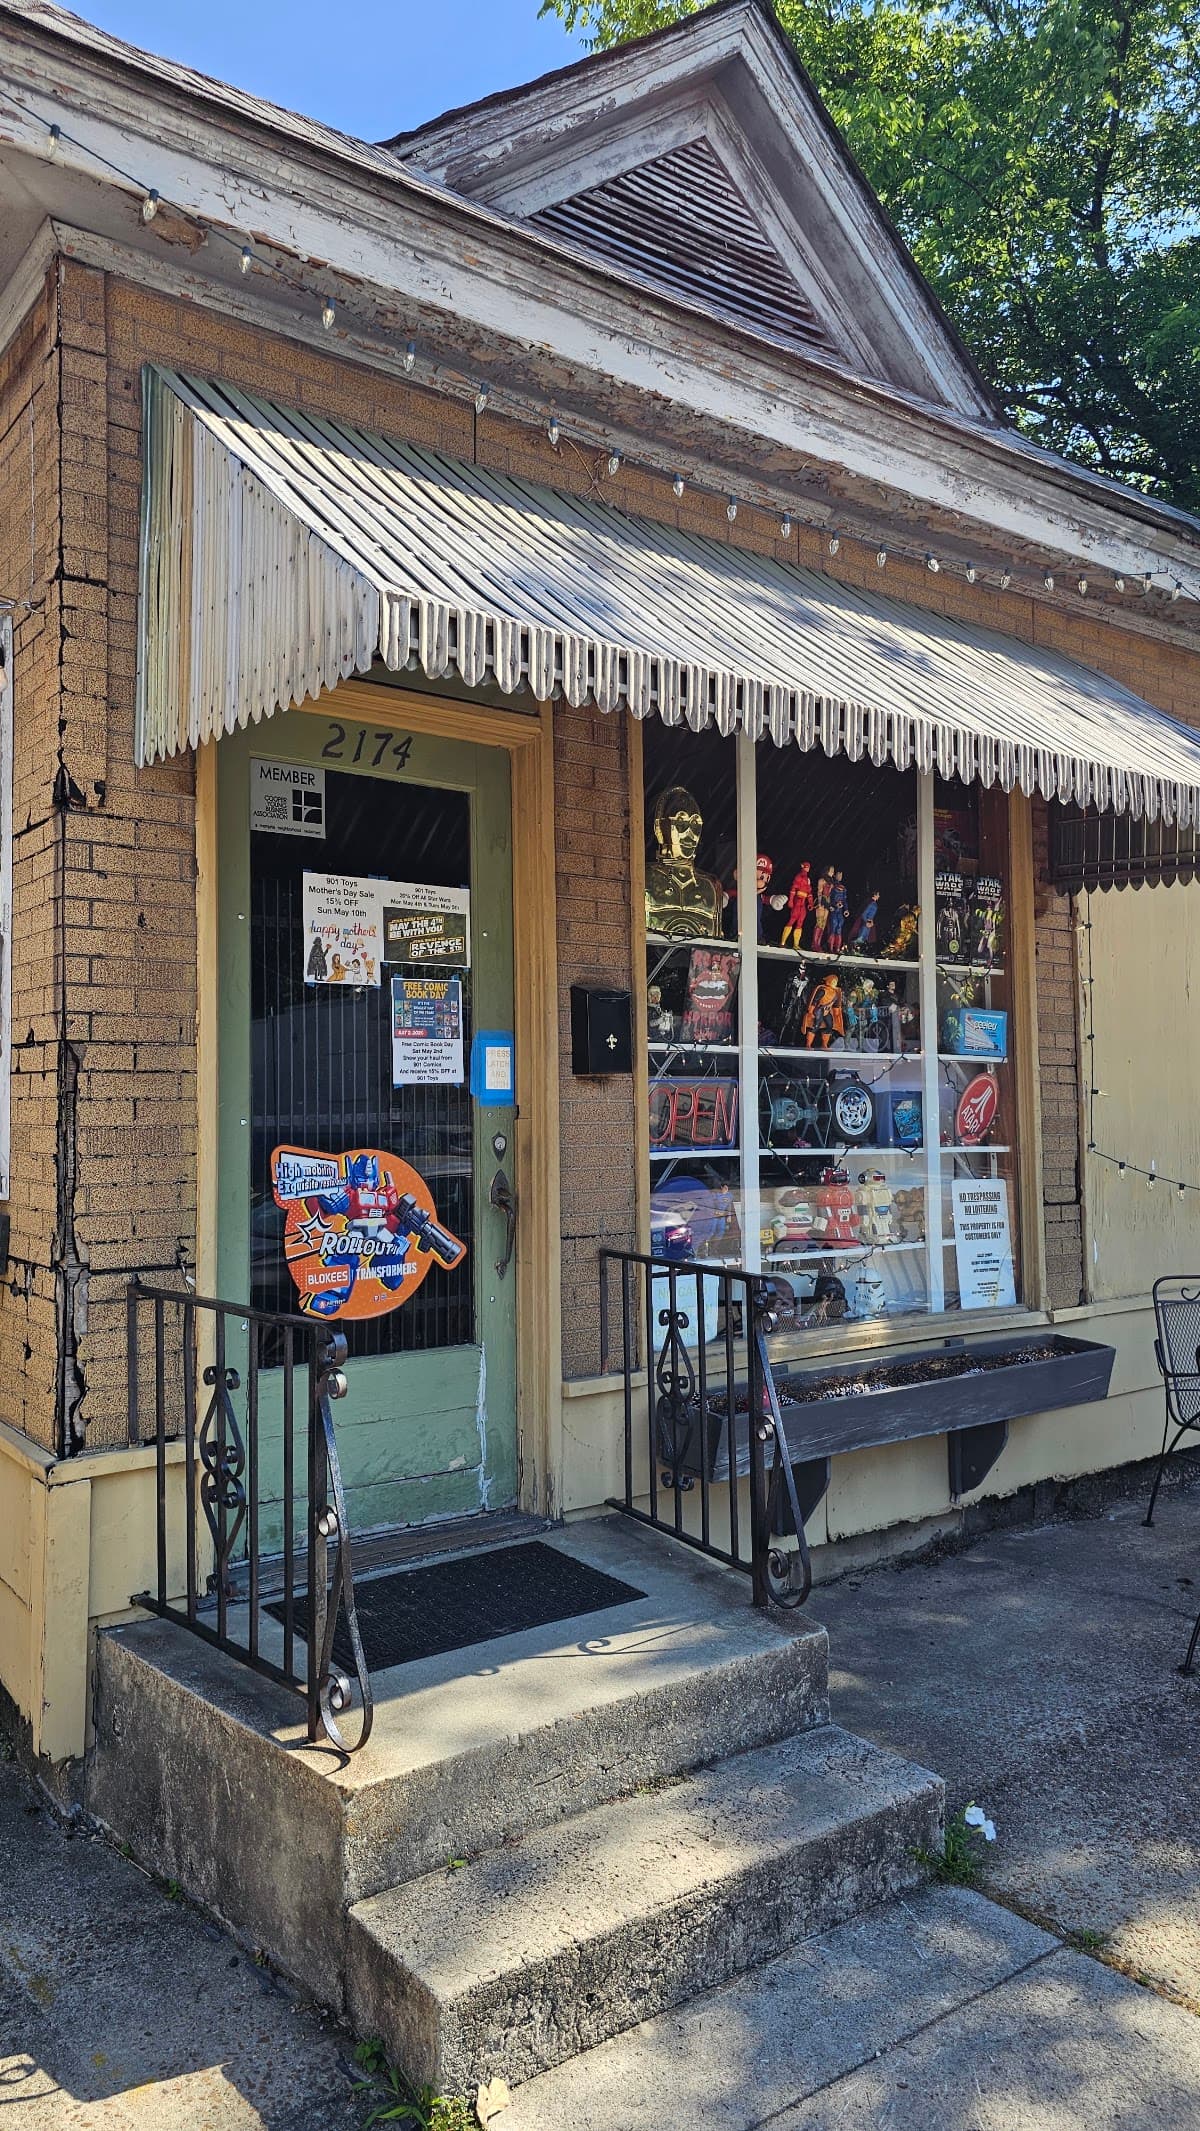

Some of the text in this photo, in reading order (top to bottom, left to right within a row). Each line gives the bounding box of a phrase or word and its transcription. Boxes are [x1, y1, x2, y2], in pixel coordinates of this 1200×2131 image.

[322, 723, 413, 771] 2174
[260, 766, 315, 786] MEMBER
[253, 810, 288, 820] ASSOCIATION
[935, 872, 962, 883] STAR
[977, 877, 1002, 888] STAR
[340, 879, 358, 888] Toys
[935, 881, 964, 892] WARS
[308, 886, 342, 896] Mother's
[343, 889, 357, 898] Day
[976, 886, 1001, 897] WARS
[326, 898, 342, 906] 15%
[334, 908, 349, 917] May
[310, 920, 340, 942] happy
[390, 922, 409, 931] MAY
[412, 920, 429, 928] THE
[403, 928, 424, 937] WITH
[425, 925, 443, 934] YOU
[340, 938, 364, 955] day
[412, 939, 461, 951] REVENGE
[403, 981, 449, 991] FREE COMIC
[406, 990, 446, 999] BOOK DAY
[649, 1087, 737, 1142] OPEN
[961, 1105, 981, 1137] ATARI
[275, 1162, 336, 1181] High mobility
[278, 1177, 319, 1196] Exquisite
[967, 1191, 1000, 1201] TRESPASSING
[972, 1204, 998, 1214] LOITERING
[960, 1223, 970, 1231] THIS
[970, 1222, 991, 1231] PROPERTY
[991, 1222, 997, 1230] IS
[964, 1231, 1001, 1240] CUSTOMERS ONLY
[307, 1262, 417, 1284] BLOKEES TRANSFORMERS
